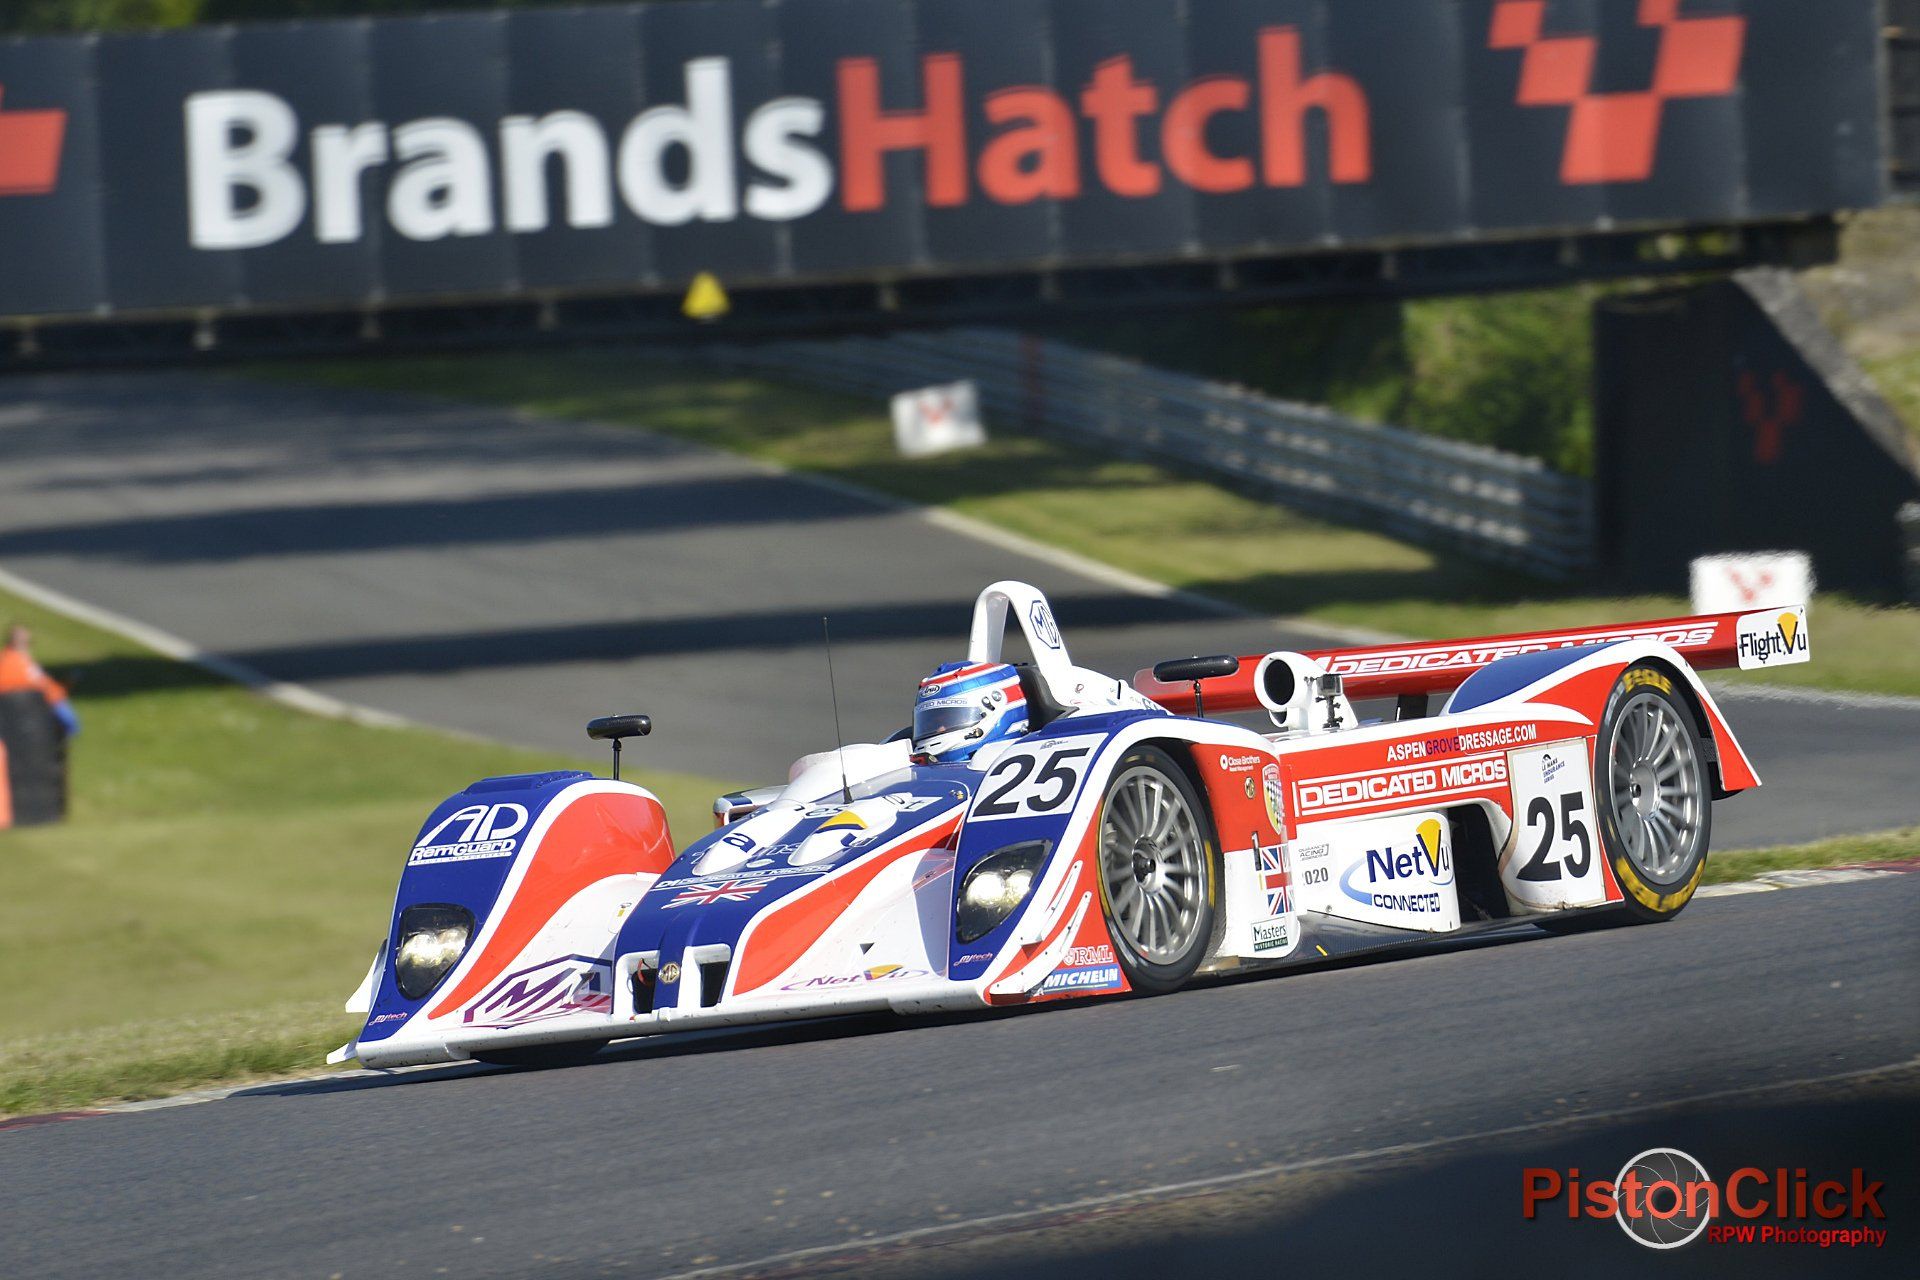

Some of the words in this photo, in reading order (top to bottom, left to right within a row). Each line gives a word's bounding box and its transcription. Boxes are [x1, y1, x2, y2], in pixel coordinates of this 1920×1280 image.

[1740, 621, 1807, 664] FlightVu
[1387, 723, 1537, 762] ASPENGROVEDRESSAGE.COM
[972, 747, 1090, 817] 25
[1301, 769, 1437, 809] DEDICATED
[1441, 759, 1507, 788] MICROS
[1366, 827, 1450, 883] NetVu
[1516, 791, 1591, 882] 25
[1302, 866, 1329, 886] 020
[1373, 893, 1440, 913] CONNECTED
[1253, 924, 1287, 942] Masters
[1074, 945, 1114, 965] RML
[1043, 968, 1119, 988] MICHELIN
